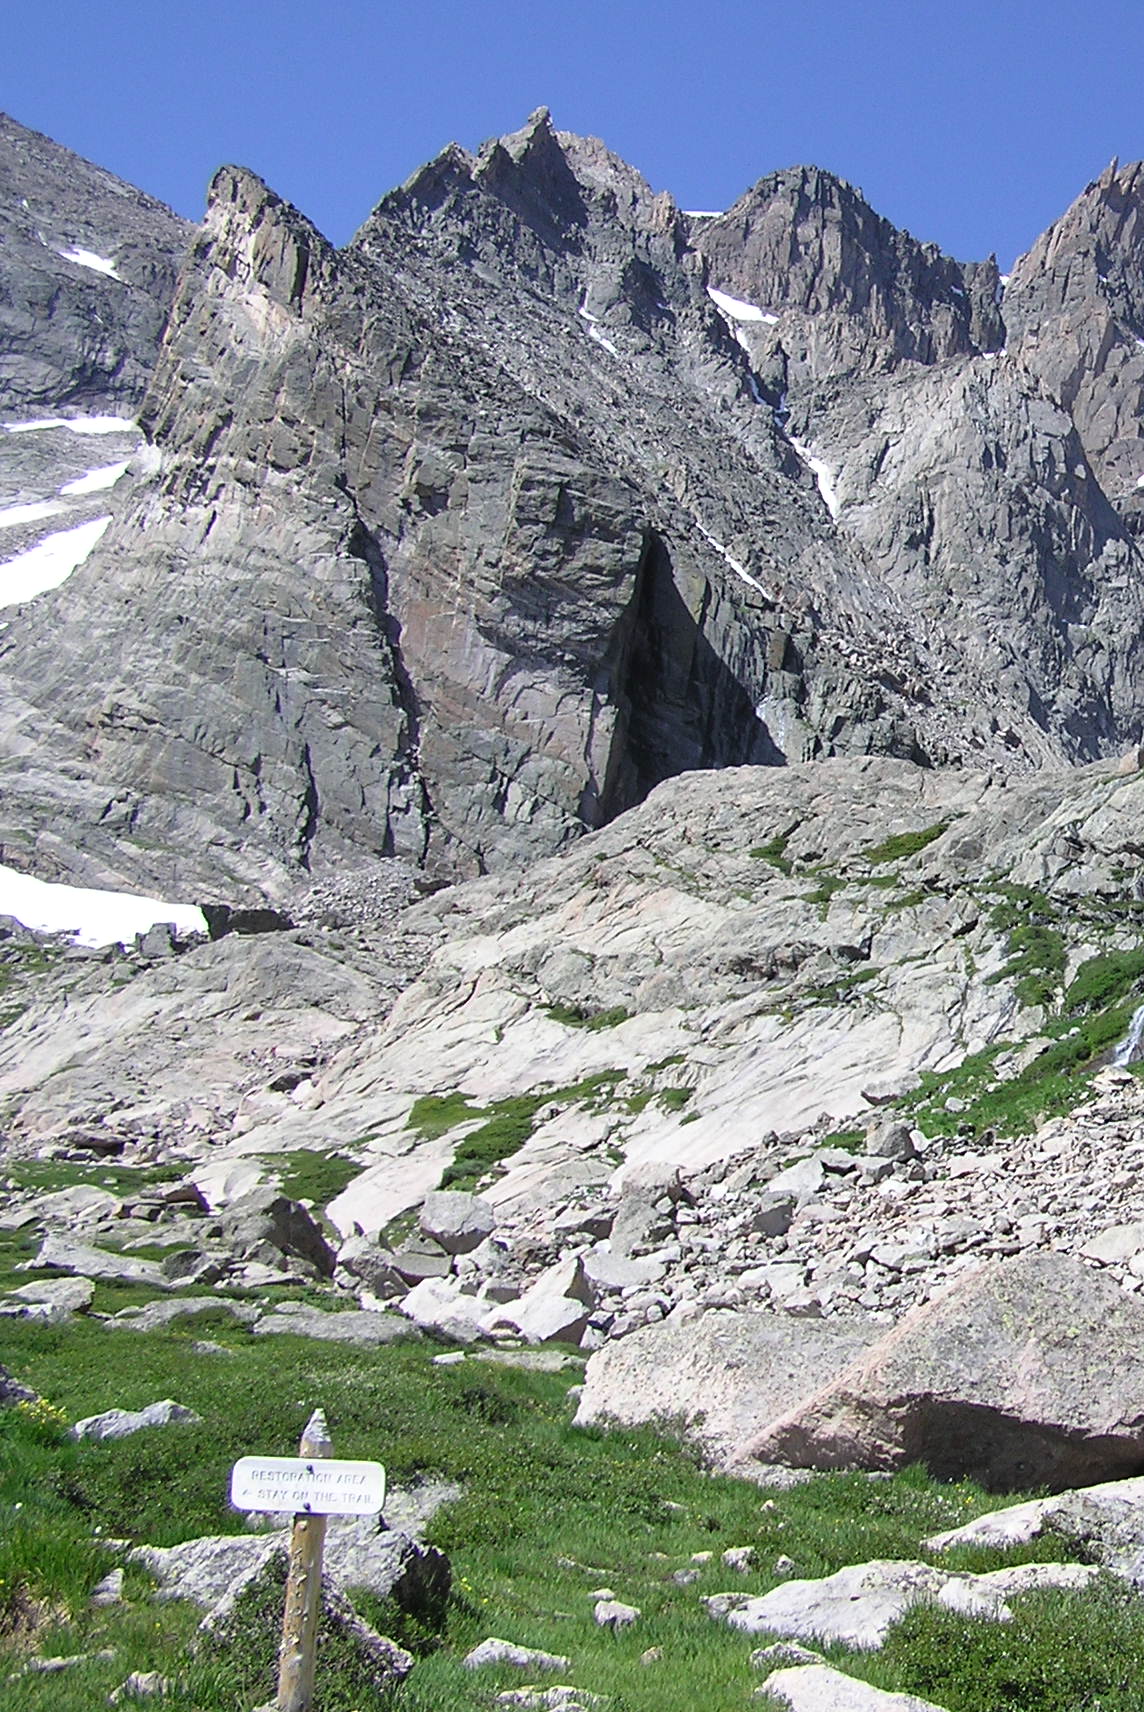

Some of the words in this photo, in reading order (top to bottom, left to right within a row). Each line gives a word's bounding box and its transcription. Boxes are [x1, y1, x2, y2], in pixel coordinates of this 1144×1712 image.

[251, 1470, 331, 1484] RESTORATION
[336, 1474, 367, 1484] AREA
[257, 1489, 288, 1499] STAY
[292, 1490, 308, 1501] ON
[314, 1491, 337, 1502] THE
[342, 1492, 375, 1504] TRAIL
